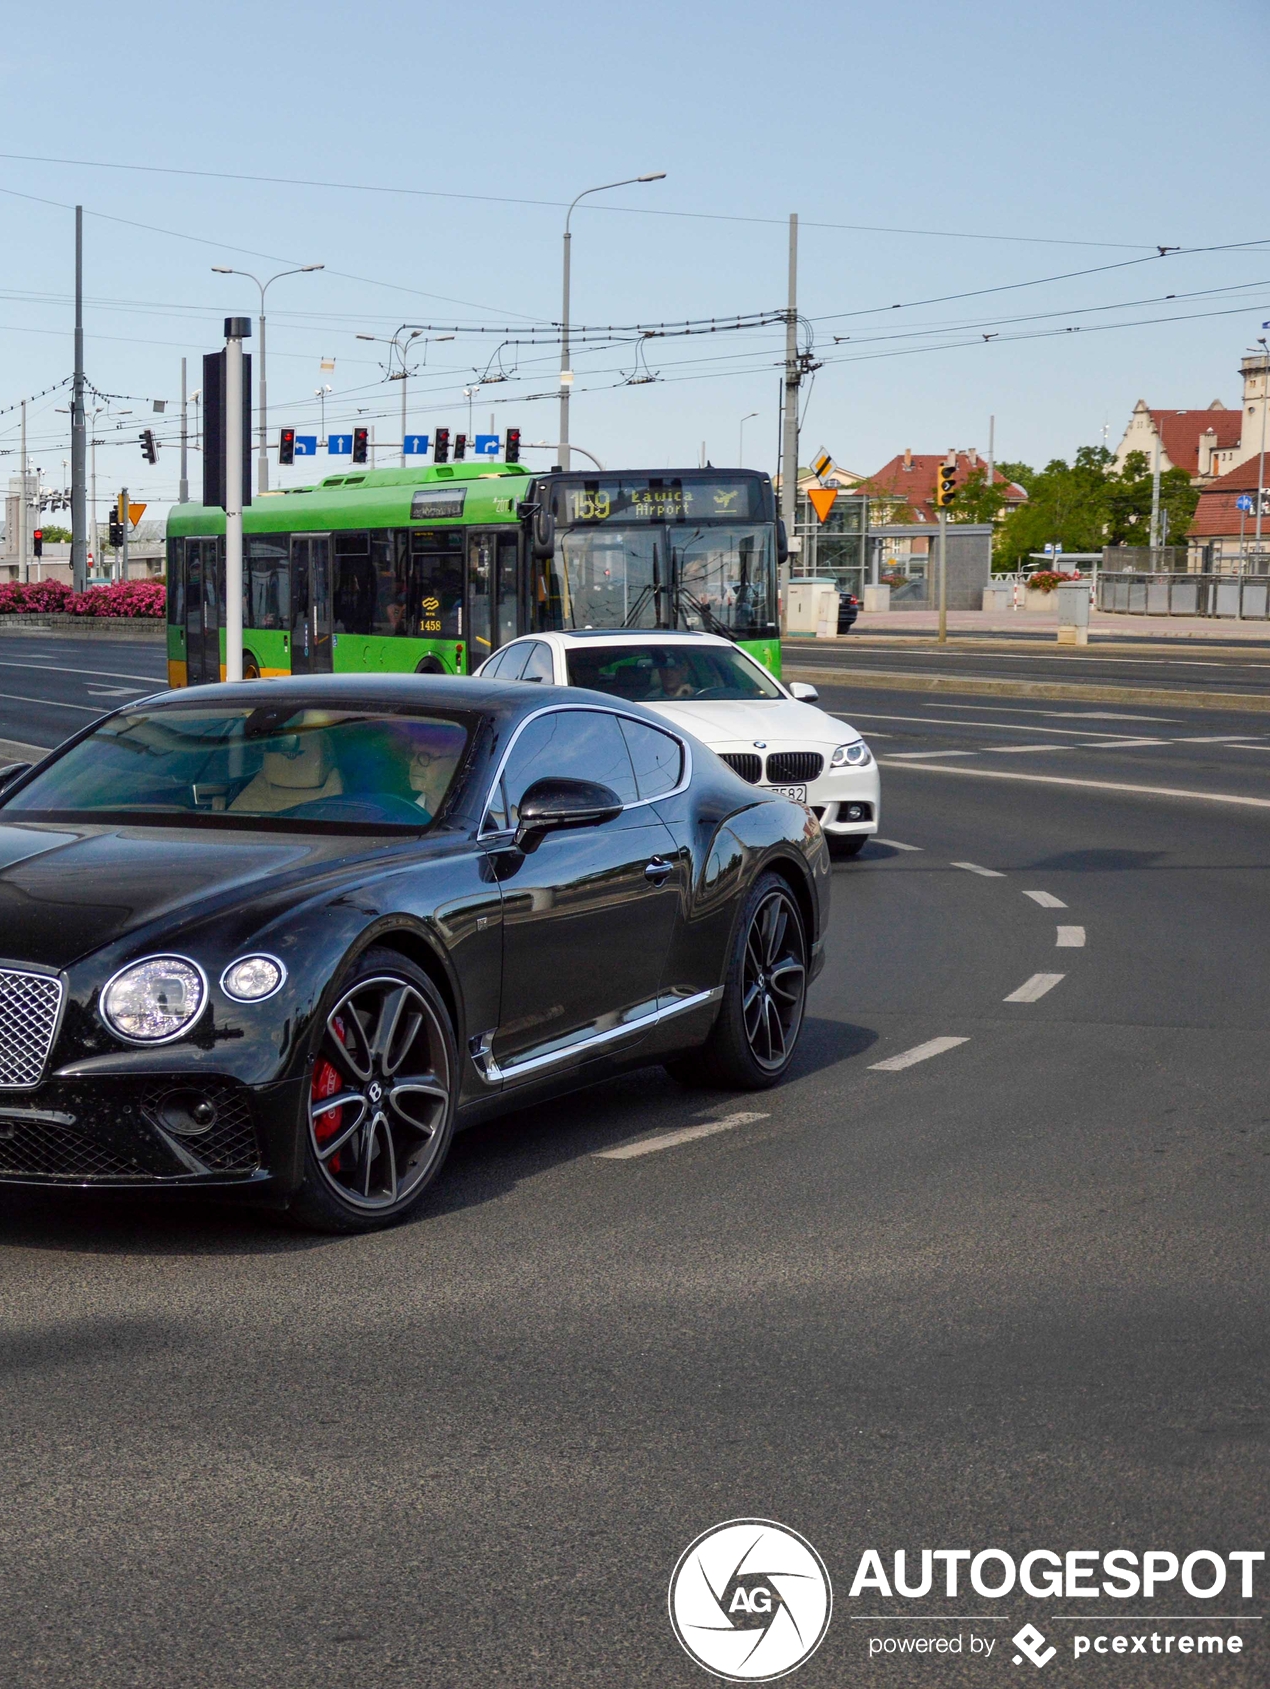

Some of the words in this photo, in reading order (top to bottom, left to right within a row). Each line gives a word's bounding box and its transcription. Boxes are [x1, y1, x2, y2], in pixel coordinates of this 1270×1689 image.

[631, 488, 694, 503] Ławica
[569, 490, 611, 520] 159
[635, 502, 690, 517] Airport
[420, 620, 442, 631] 1458
